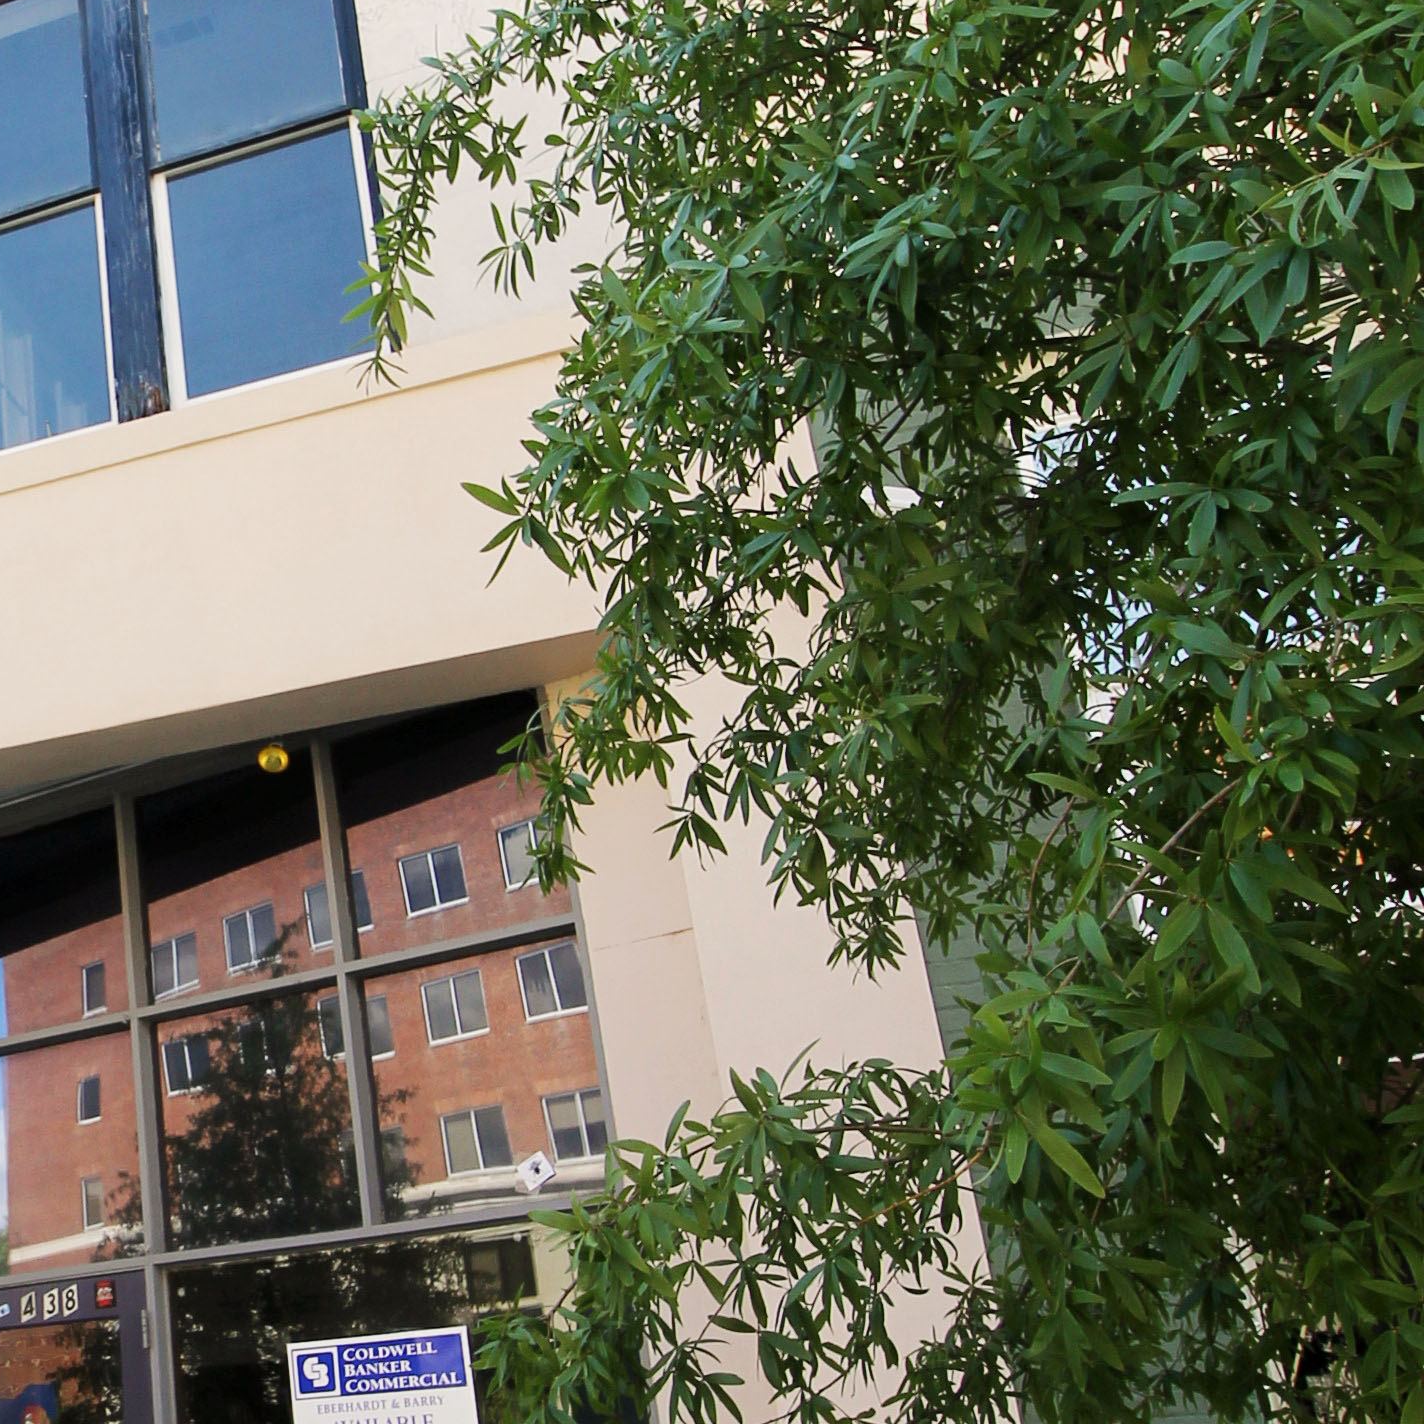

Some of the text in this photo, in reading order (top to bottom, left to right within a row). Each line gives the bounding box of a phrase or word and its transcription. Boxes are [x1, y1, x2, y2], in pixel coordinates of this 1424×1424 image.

[23, 1289, 75, 1315] 438
[343, 1342, 438, 1361] COLDWELL
[344, 1360, 411, 1377] BANKER
[345, 1372, 462, 1393] COMMERCIAL
[317, 1395, 444, 1415] EBERHARDT & BARRY
